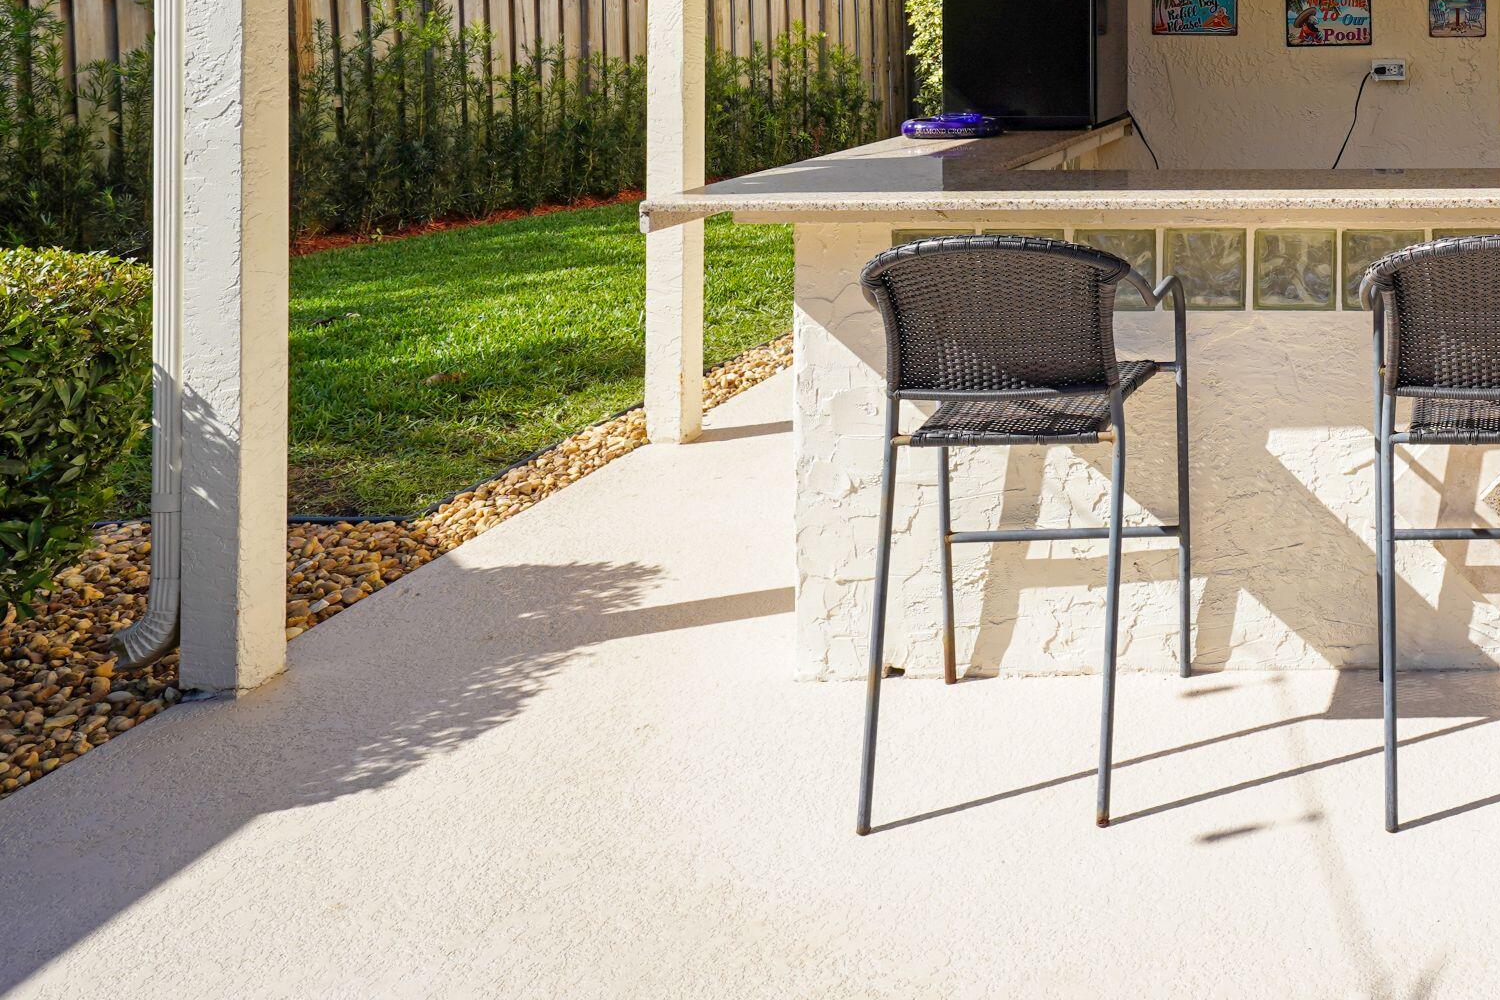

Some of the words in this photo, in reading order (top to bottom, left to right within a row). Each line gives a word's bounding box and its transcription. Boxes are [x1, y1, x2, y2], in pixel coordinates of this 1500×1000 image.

[1167, 5, 1198, 21] Refill
[1320, 6, 1341, 21] To
[1342, 13, 1368, 26] Our
[1167, 17, 1202, 32] Please!
[1323, 27, 1369, 42] Pool!
[915, 128, 946, 136] DIAMOND
[947, 127, 976, 135] CROWN
